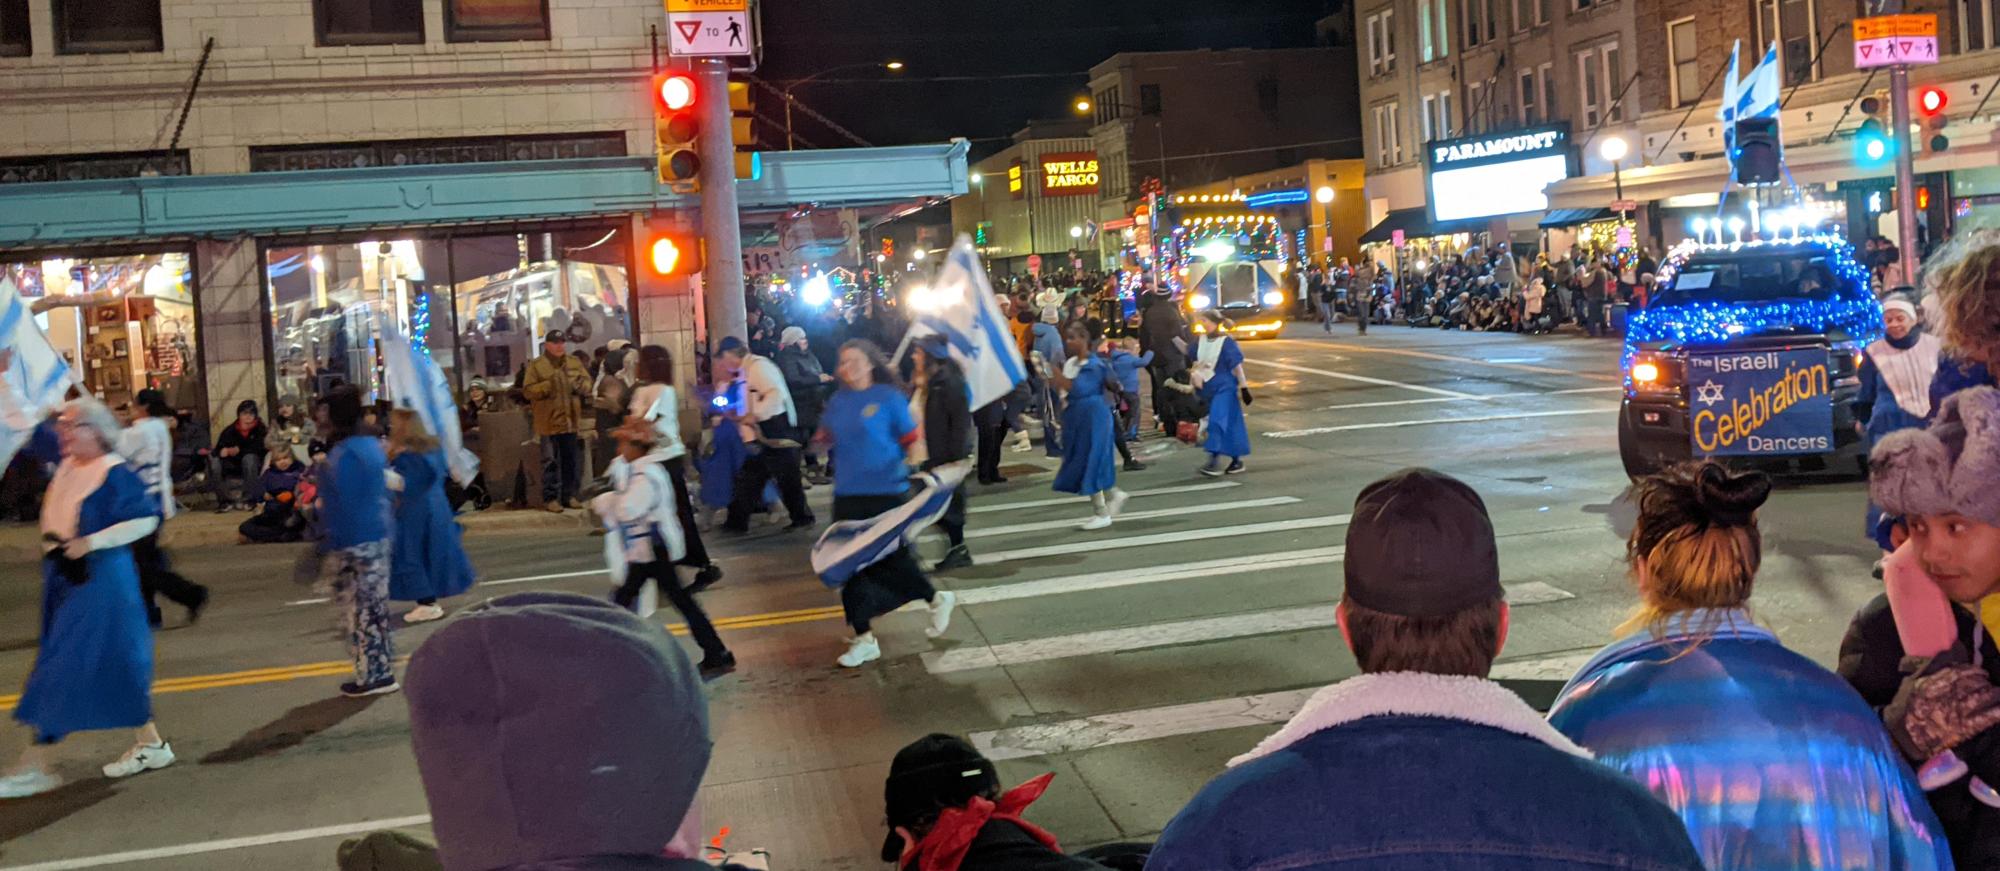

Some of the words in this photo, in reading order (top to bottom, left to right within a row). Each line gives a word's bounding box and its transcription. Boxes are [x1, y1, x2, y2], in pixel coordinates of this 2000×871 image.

[706, 27, 719, 37] TO
[1435, 131, 1557, 163] PARAMOUNT
[1044, 160, 1098, 175] WELLS
[1046, 173, 1099, 188] FARGO
[1691, 358, 1713, 367] The
[1714, 352, 1779, 373] Israeli
[1694, 360, 1828, 451] Celebration
[1747, 436, 1829, 451] Dancers
